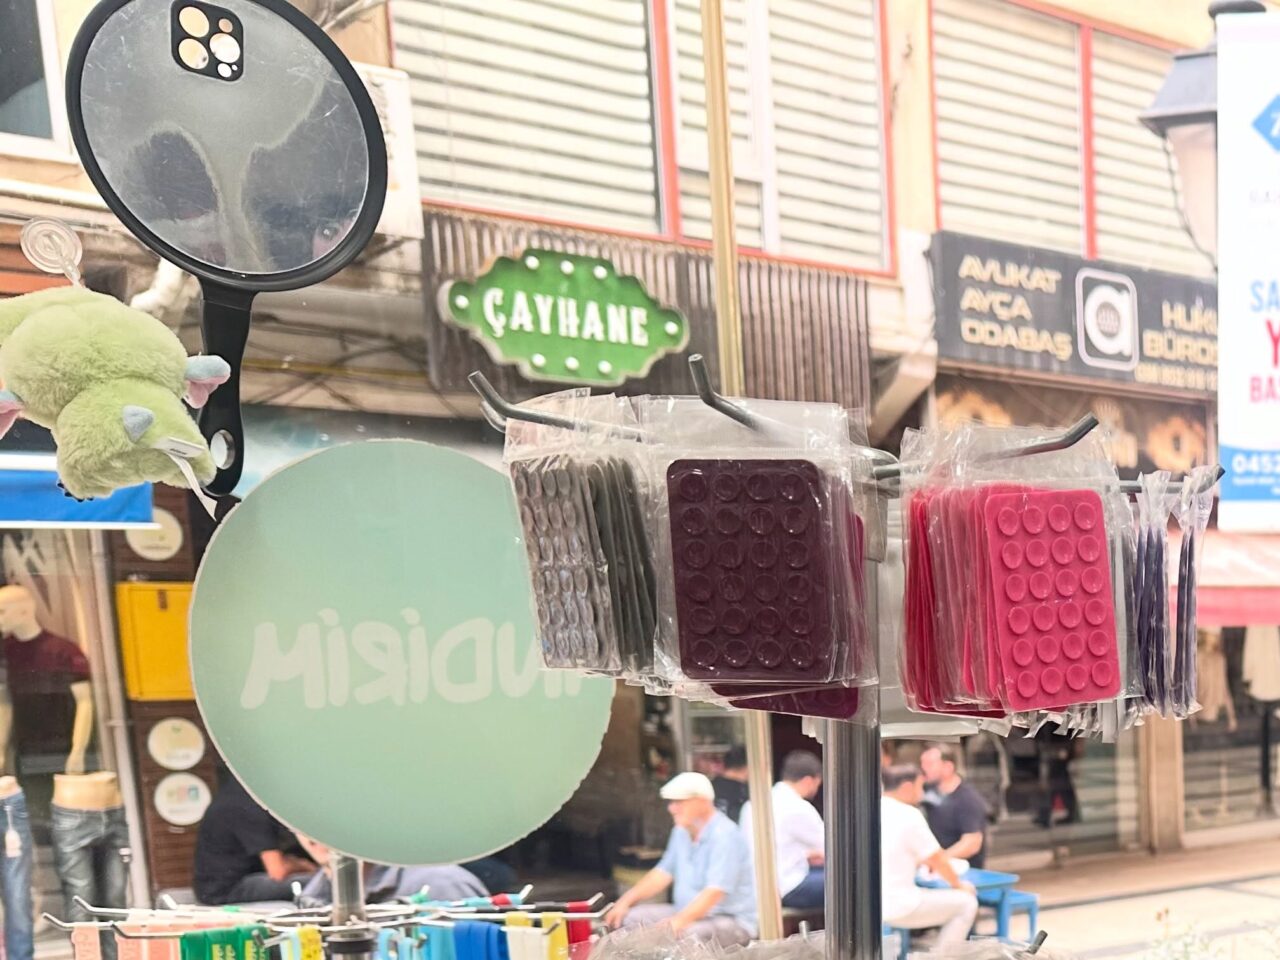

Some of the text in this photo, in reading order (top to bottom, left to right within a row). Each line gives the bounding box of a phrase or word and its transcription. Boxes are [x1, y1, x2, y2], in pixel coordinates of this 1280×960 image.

[957, 254, 1062, 294] AVUKAT
[483, 287, 649, 347] ÇAYHANE
[960, 286, 1033, 321] AYÇA
[960, 318, 1073, 362] ODABAŞ
